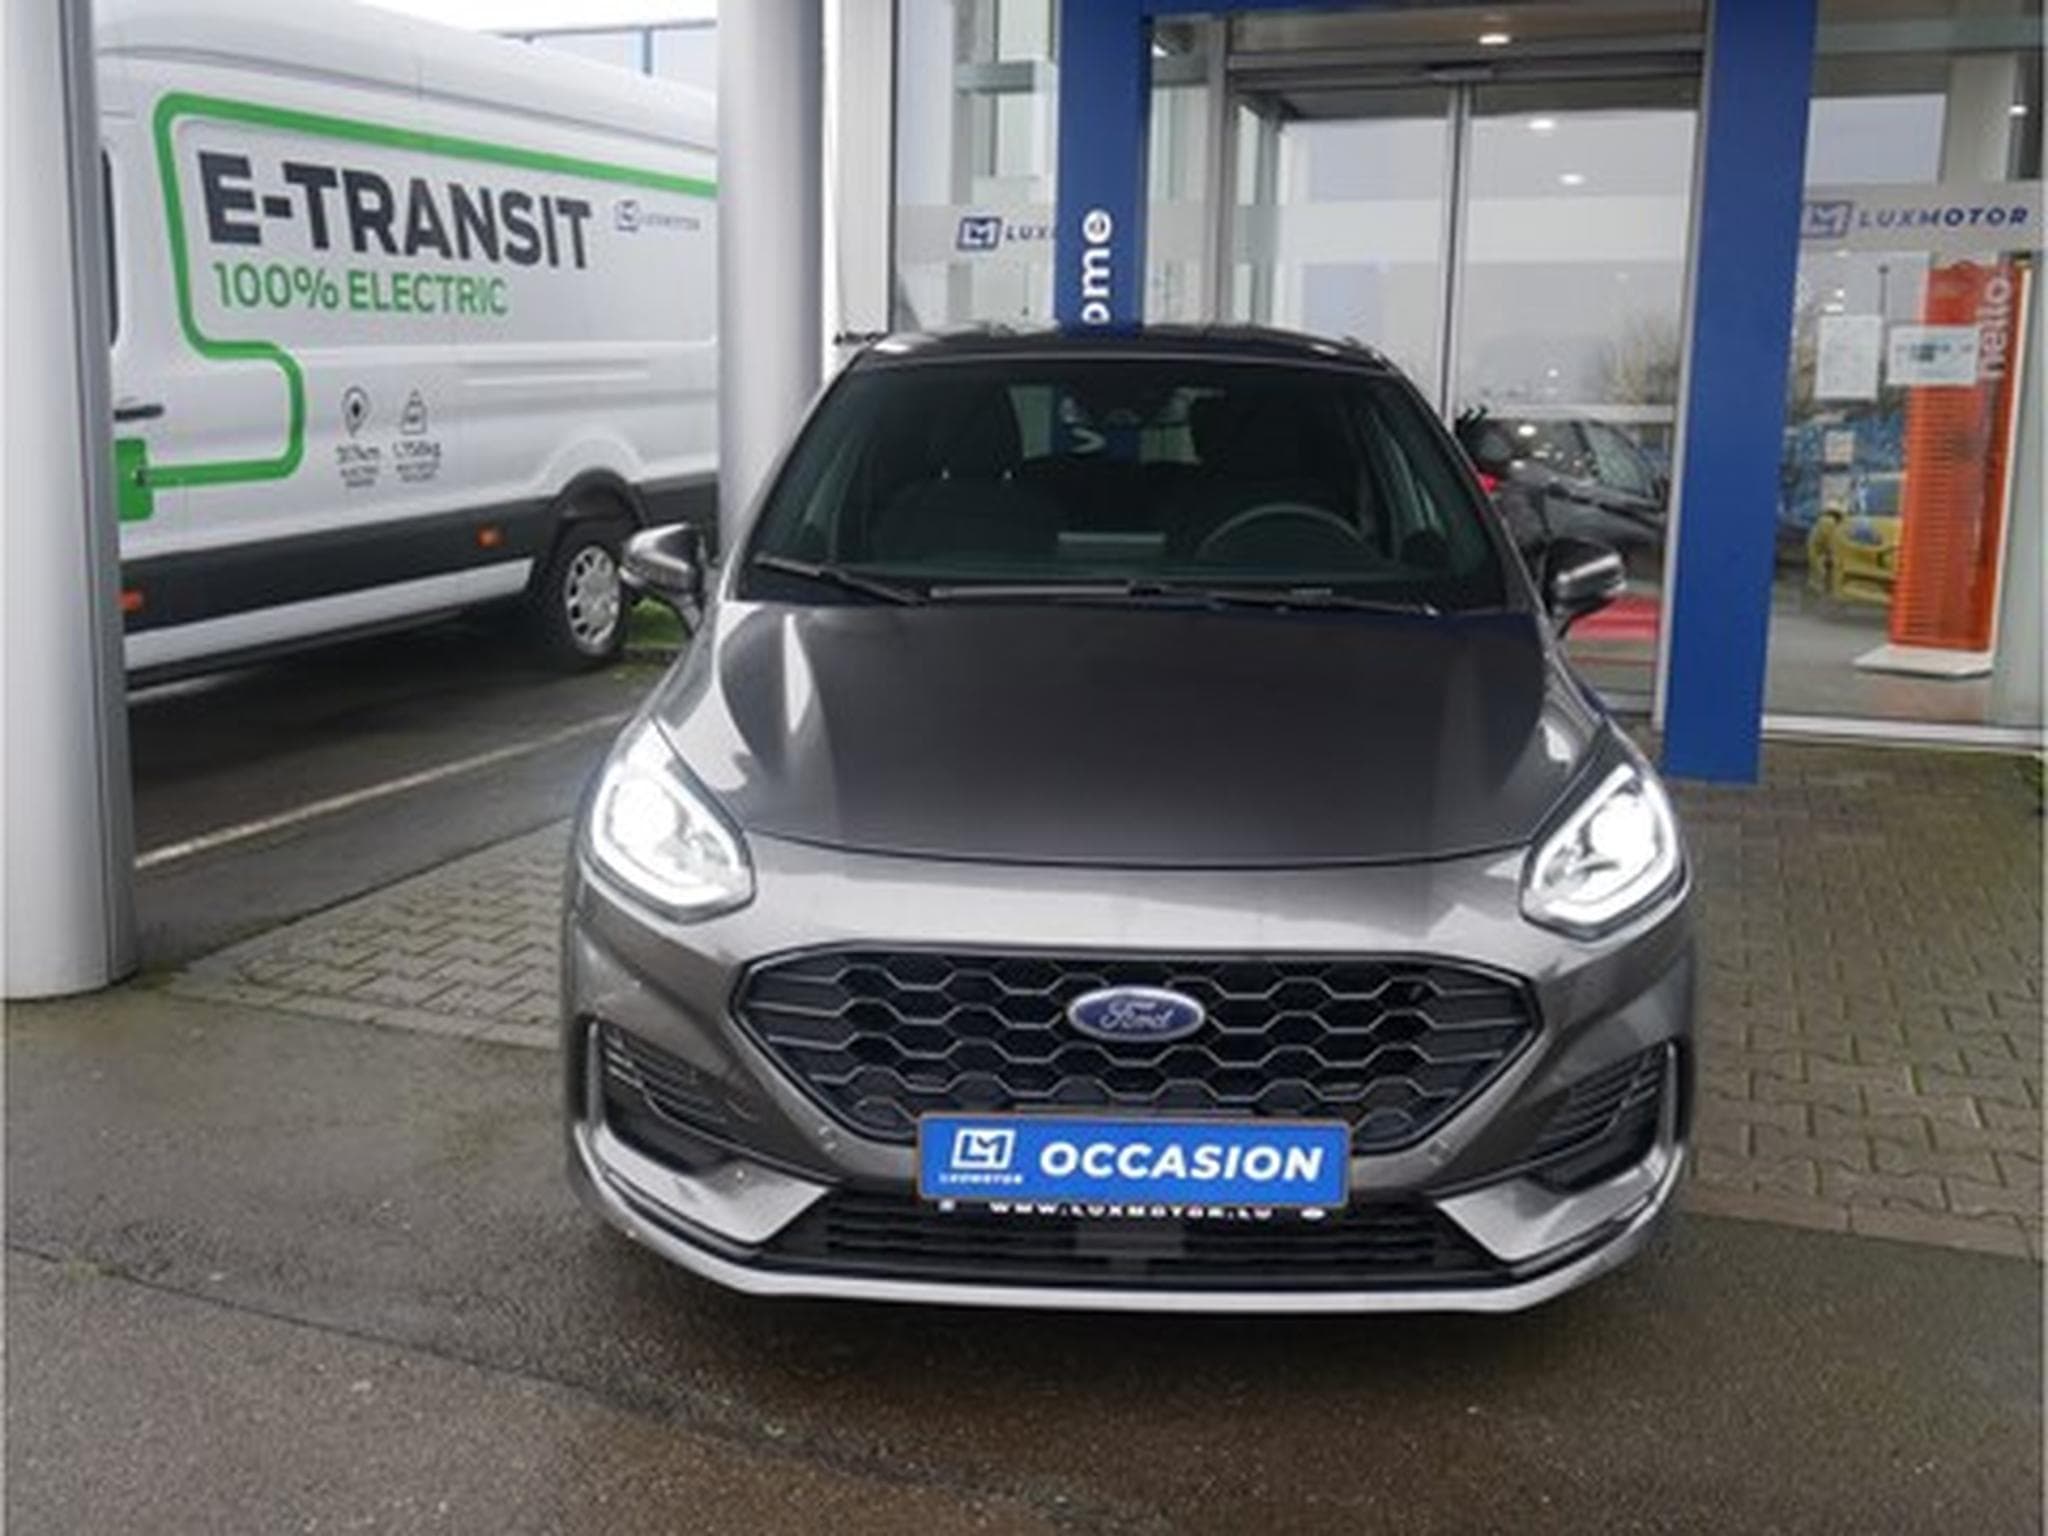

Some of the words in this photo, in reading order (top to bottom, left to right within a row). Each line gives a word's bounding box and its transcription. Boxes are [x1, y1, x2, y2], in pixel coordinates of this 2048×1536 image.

[197, 151, 592, 269] E-TRANSIT
[1858, 207, 2029, 229] LUXMOTOR
[1005, 225, 1057, 240] LUX
[213, 261, 339, 310] 100%
[347, 269, 508, 316] ELECTRIC
[1100, 999, 1176, 1030] Ford
[1039, 1141, 1323, 1182] OCCASION
